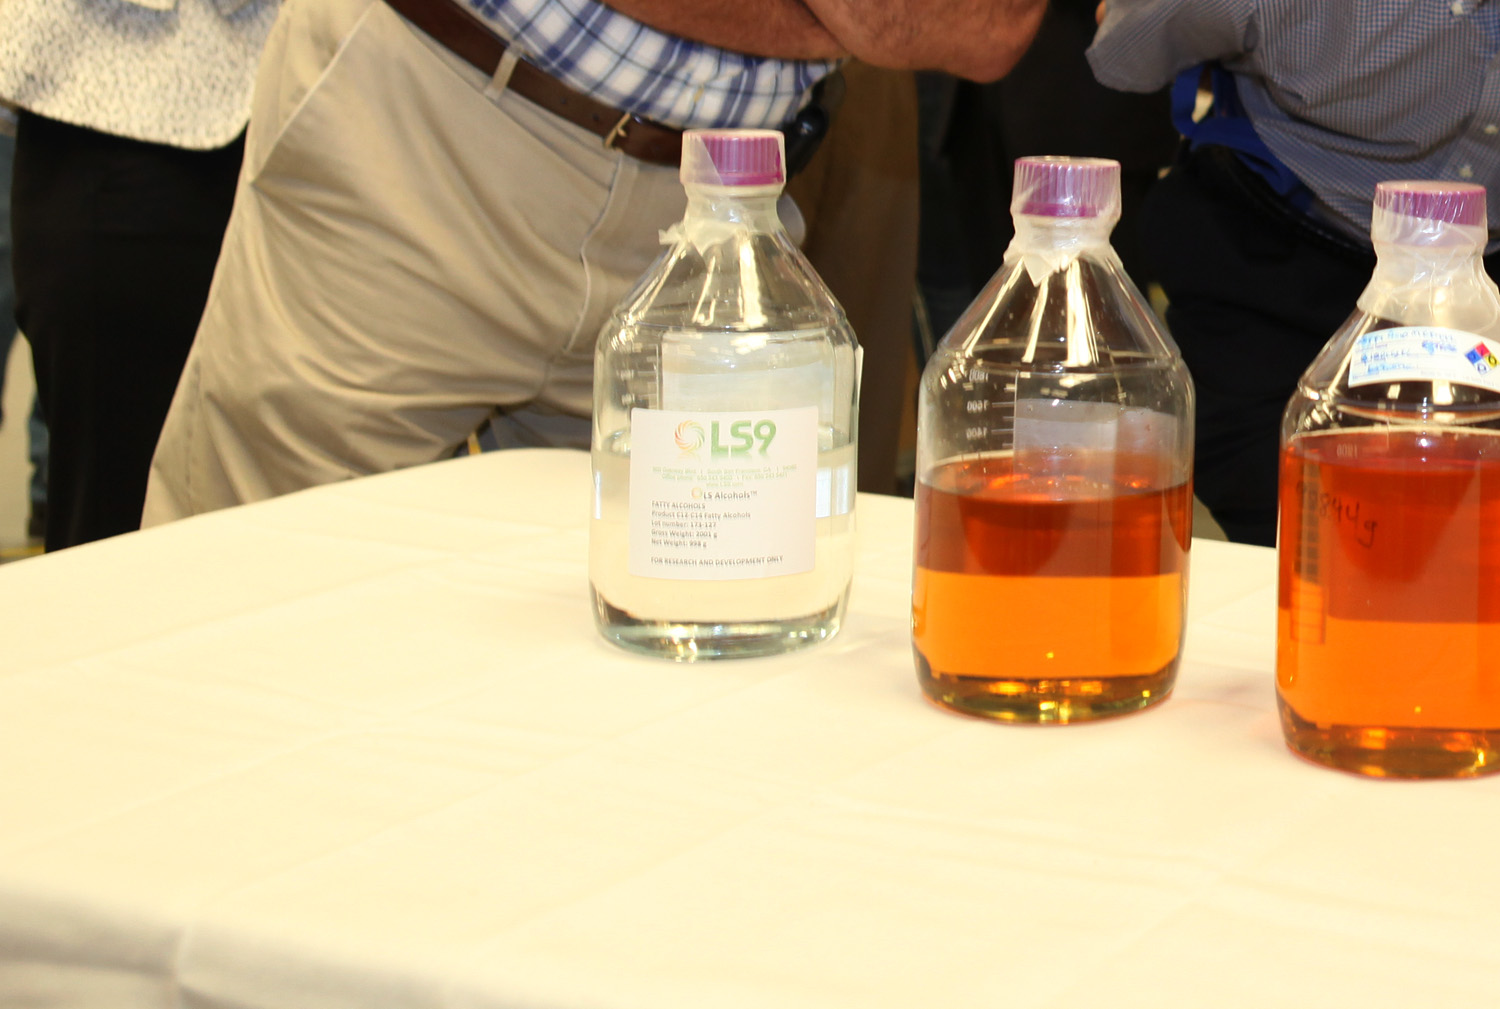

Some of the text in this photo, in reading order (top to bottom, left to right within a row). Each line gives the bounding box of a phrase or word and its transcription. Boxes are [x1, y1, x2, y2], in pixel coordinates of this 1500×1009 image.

[711, 419, 777, 456] LS9
[703, 492, 713, 500] LS
[651, 500, 706, 510] FATTY ALCOHOLS
[651, 510, 675, 518] Product
[704, 512, 721, 520] Fatty
[723, 511, 751, 519] Alcohols
[651, 529, 668, 537] Gross
[651, 538, 662, 546] Net
[650, 555, 784, 567] FOR RESEARCH AND DEVELOPMENT ONLY
